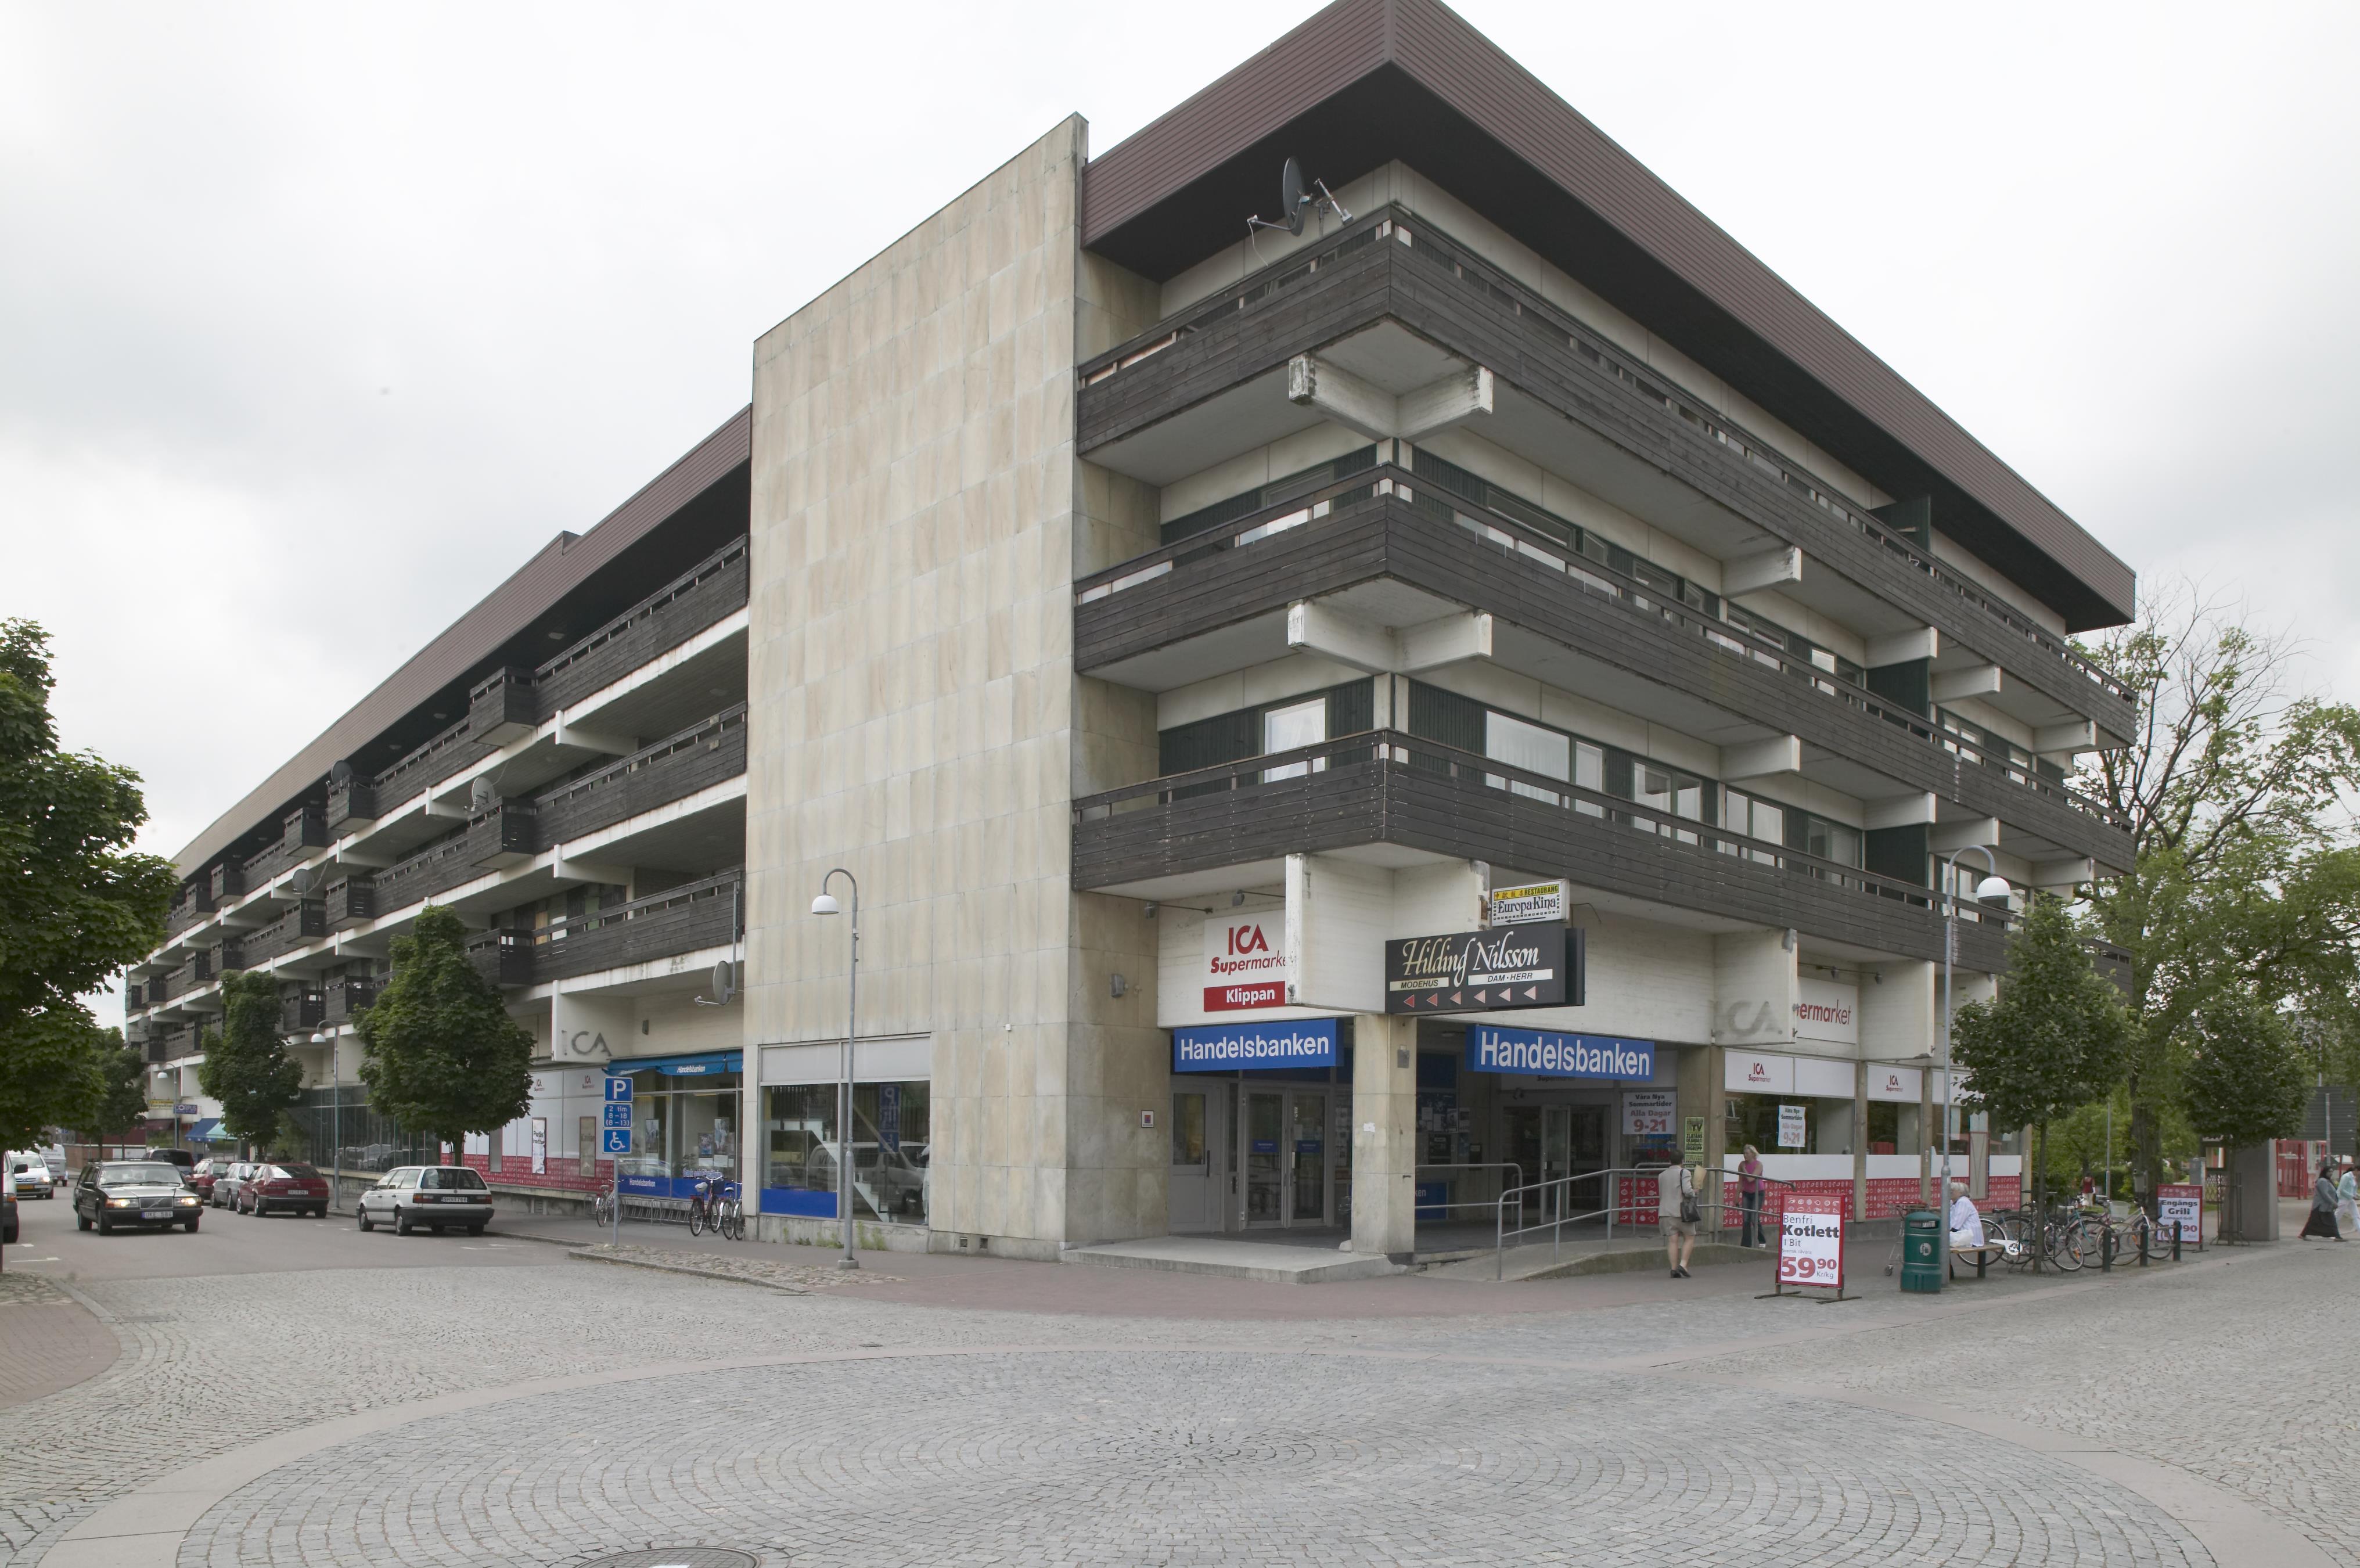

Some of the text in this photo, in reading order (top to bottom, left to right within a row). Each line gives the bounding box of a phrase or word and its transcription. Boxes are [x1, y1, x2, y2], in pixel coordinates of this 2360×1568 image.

[1524, 885, 1558, 896] RESTAURANG
[1228, 923, 1269, 955] ICA
[1210, 950, 1286, 976] Supermarke
[1402, 931, 1539, 987] Hilding Nilsson
[1401, 979, 1439, 988] MODEHUS
[1226, 988, 1275, 1005] Klippan
[1796, 999, 1851, 1026] ermarket
[1181, 1033, 1329, 1060] Handelsbanken
[1480, 1031, 1649, 1076] Handelsbanken
[677, 1065, 706, 1073] Handelsbanken
[1753, 1063, 1765, 1075] ICA
[1890, 1074, 1898, 1086] ICA
[613, 1080, 627, 1099] P
[1634, 1119, 1667, 1132] 9-21
[629, 1178, 656, 1187] Handelsbanken
[2161, 1199, 2198, 1207] Engångs
[1783, 1214, 1812, 1224] Benfri
[1783, 1224, 1840, 1238] Kotlett
[1790, 1239, 1801, 1247] Bit
[1782, 1256, 1837, 1278] 59 90
[1816, 1271, 1834, 1279] Kr/kg
